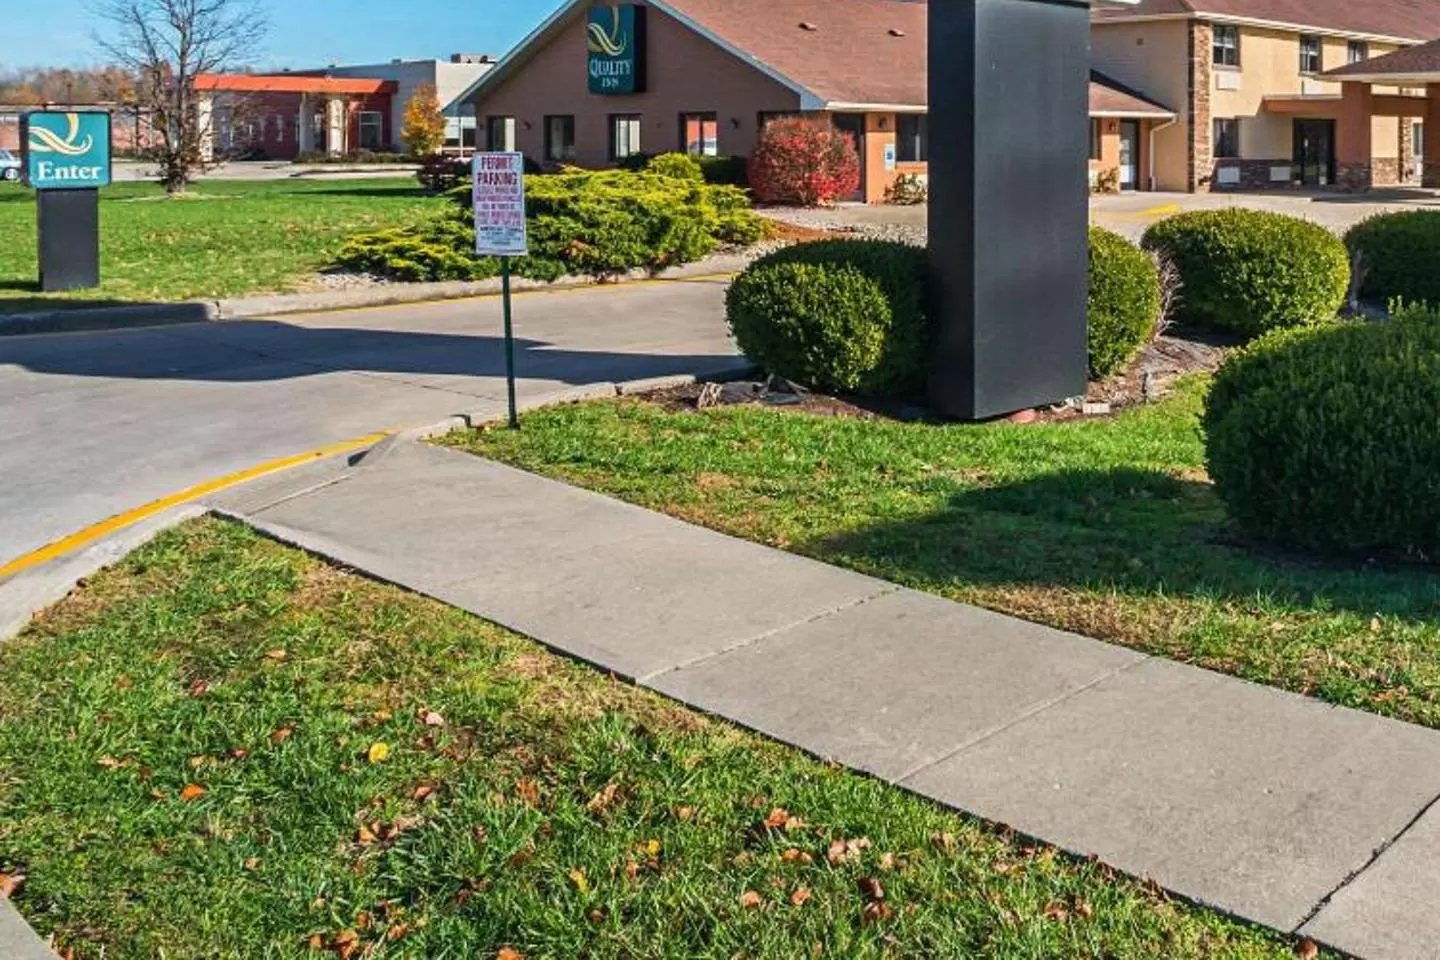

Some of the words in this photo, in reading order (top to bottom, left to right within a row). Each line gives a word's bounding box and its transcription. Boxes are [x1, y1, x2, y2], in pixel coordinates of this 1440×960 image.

[589, 58, 631, 78] QUALITY
[602, 77, 620, 89] INN
[37, 160, 104, 181] Enter
[477, 171, 517, 185] PARKING
